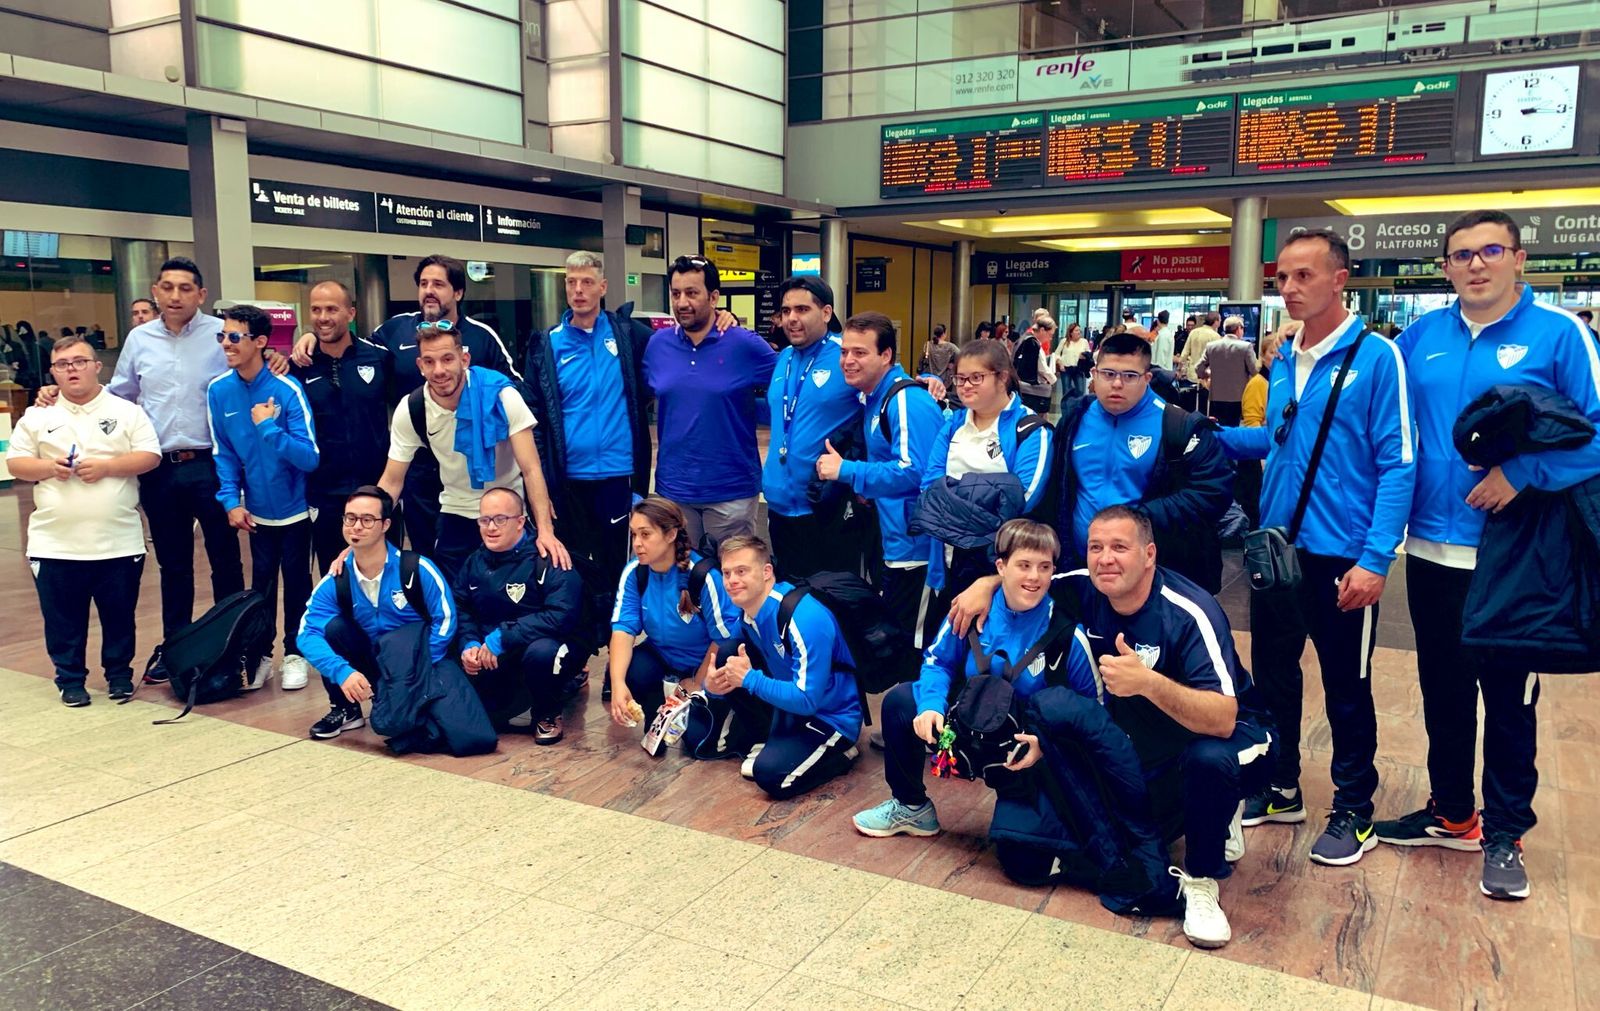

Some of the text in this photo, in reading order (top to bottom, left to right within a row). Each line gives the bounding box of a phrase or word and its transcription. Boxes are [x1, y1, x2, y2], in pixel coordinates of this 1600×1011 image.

[1036, 55, 1095, 79] renfe
[955, 69, 1015, 84] 912 320 320
[1080, 75, 1113, 89] AVE
[955, 83, 1014, 95] www.renfe.com
[1426, 81, 1451, 90] adif
[1523, 78, 1540, 88] 12
[1206, 101, 1228, 110] adif
[1243, 95, 1284, 107] Llegadas
[1491, 109, 1502, 119] 9
[1556, 103, 1567, 114] 3
[1020, 117, 1039, 126] adif
[1050, 112, 1086, 124] Llegadas
[885, 127, 916, 139] Llegadas
[1521, 135, 1532, 145] 6
[273, 190, 360, 211] Venta de billetes
[396, 203, 474, 223] Atención al cliente
[497, 214, 541, 230] Información
[1376, 222, 1447, 237] Acceso a
[1375, 238, 1439, 249] PLATFORMS
[1005, 259, 1050, 271] Llegadas
[1152, 254, 1204, 267] No pasar
